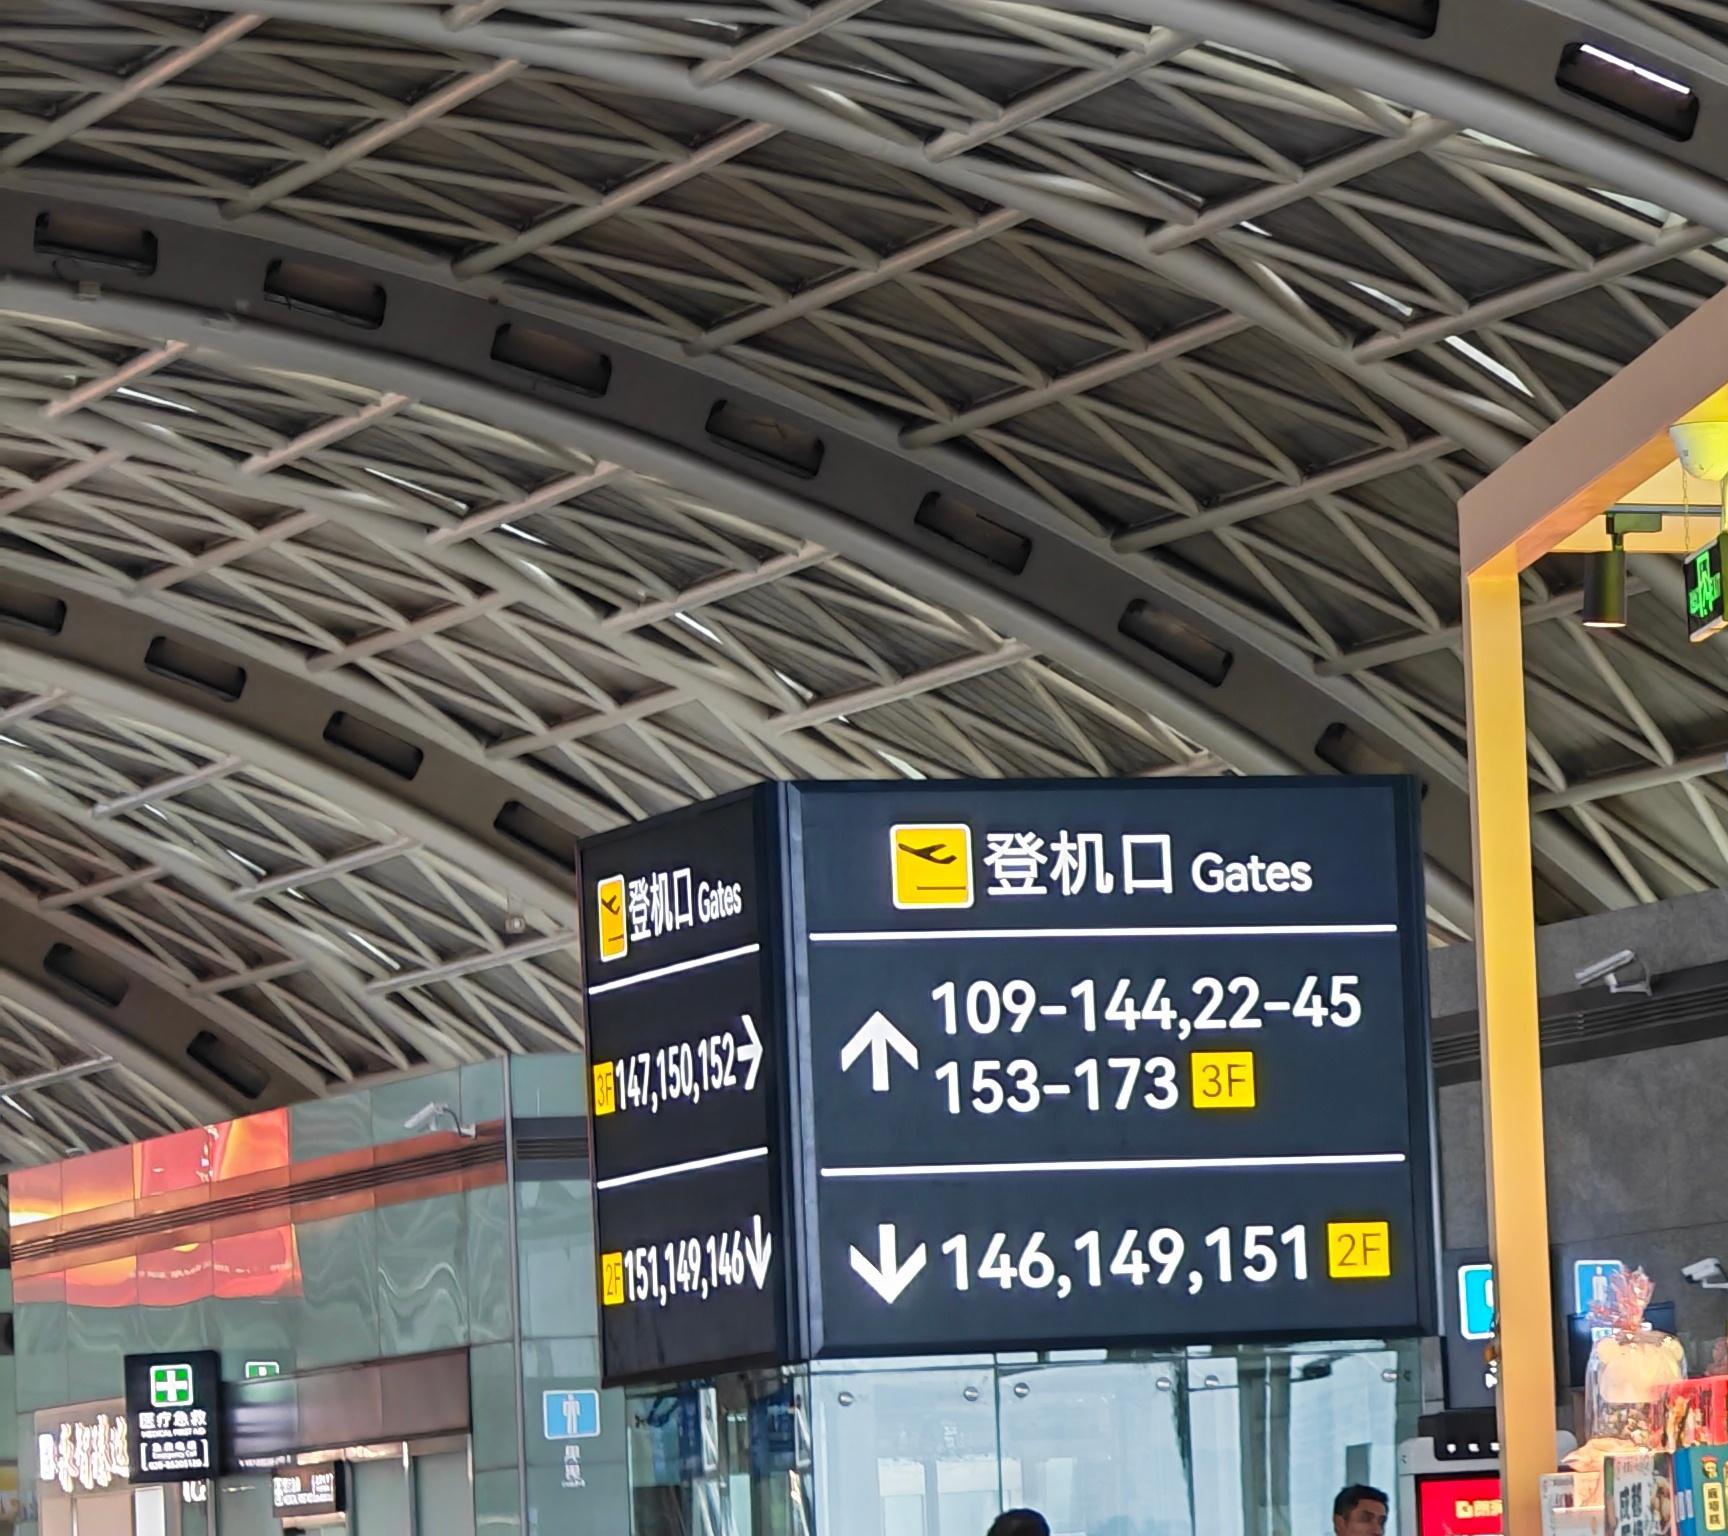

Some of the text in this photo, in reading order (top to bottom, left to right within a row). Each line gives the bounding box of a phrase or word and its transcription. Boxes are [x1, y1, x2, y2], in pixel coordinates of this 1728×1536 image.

[984, 832, 1313, 898] 登机口 Gates
[627, 867, 742, 942] 登机口 Gates
[931, 974, 1363, 1041] 109-144,22-45
[595, 1040, 738, 1114] 3F 147,150,152
[934, 1056, 1248, 1116] 153-173 3F
[604, 1237, 745, 1306] 2F 151,149,146
[941, 1224, 1382, 1298] 146,149,151 2F
